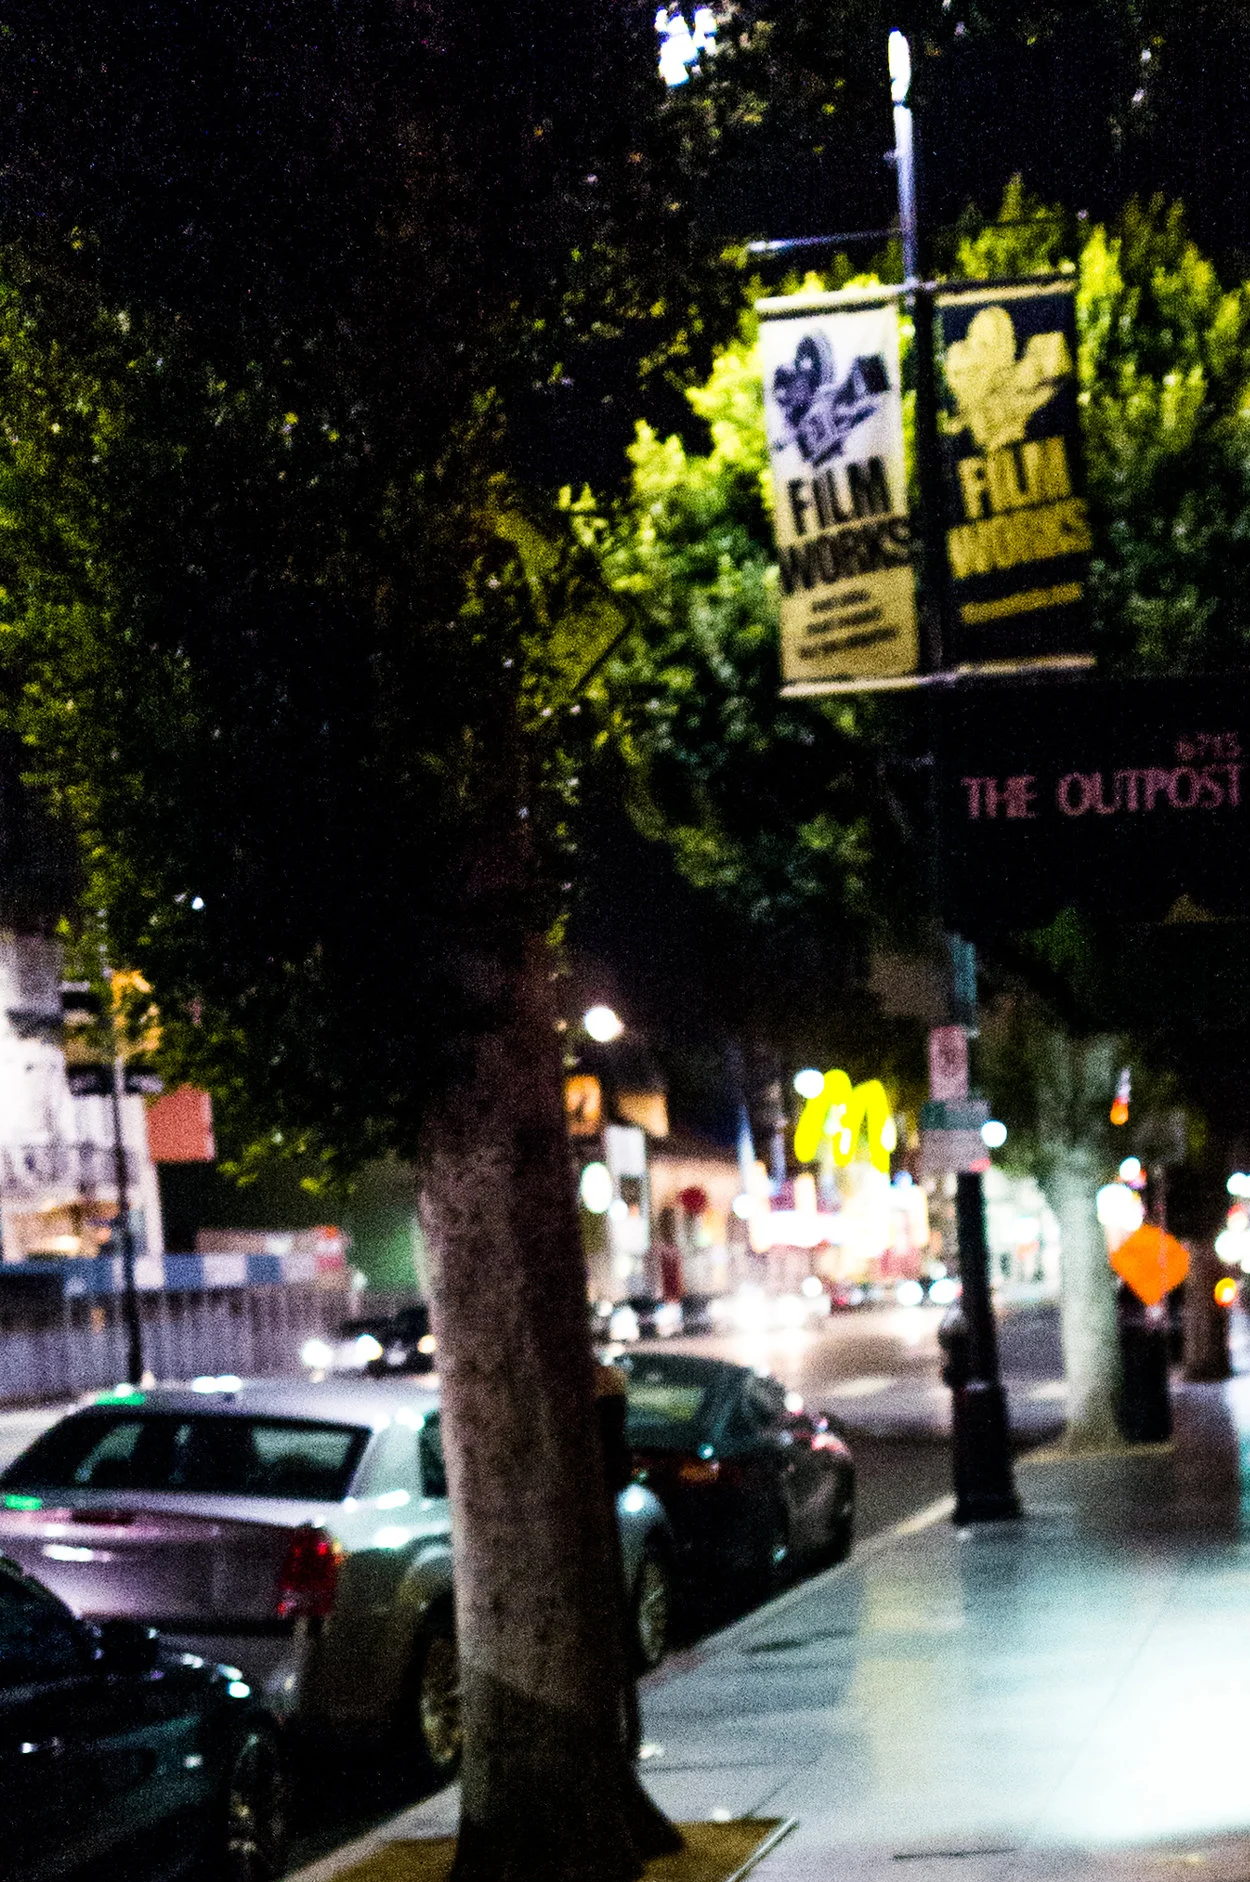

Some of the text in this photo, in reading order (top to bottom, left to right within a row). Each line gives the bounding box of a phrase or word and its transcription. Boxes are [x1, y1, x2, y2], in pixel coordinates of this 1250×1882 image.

[787, 455, 892, 536] FILM
[960, 775, 1037, 819] THE
[1056, 763, 1243, 816] OUTPOST
